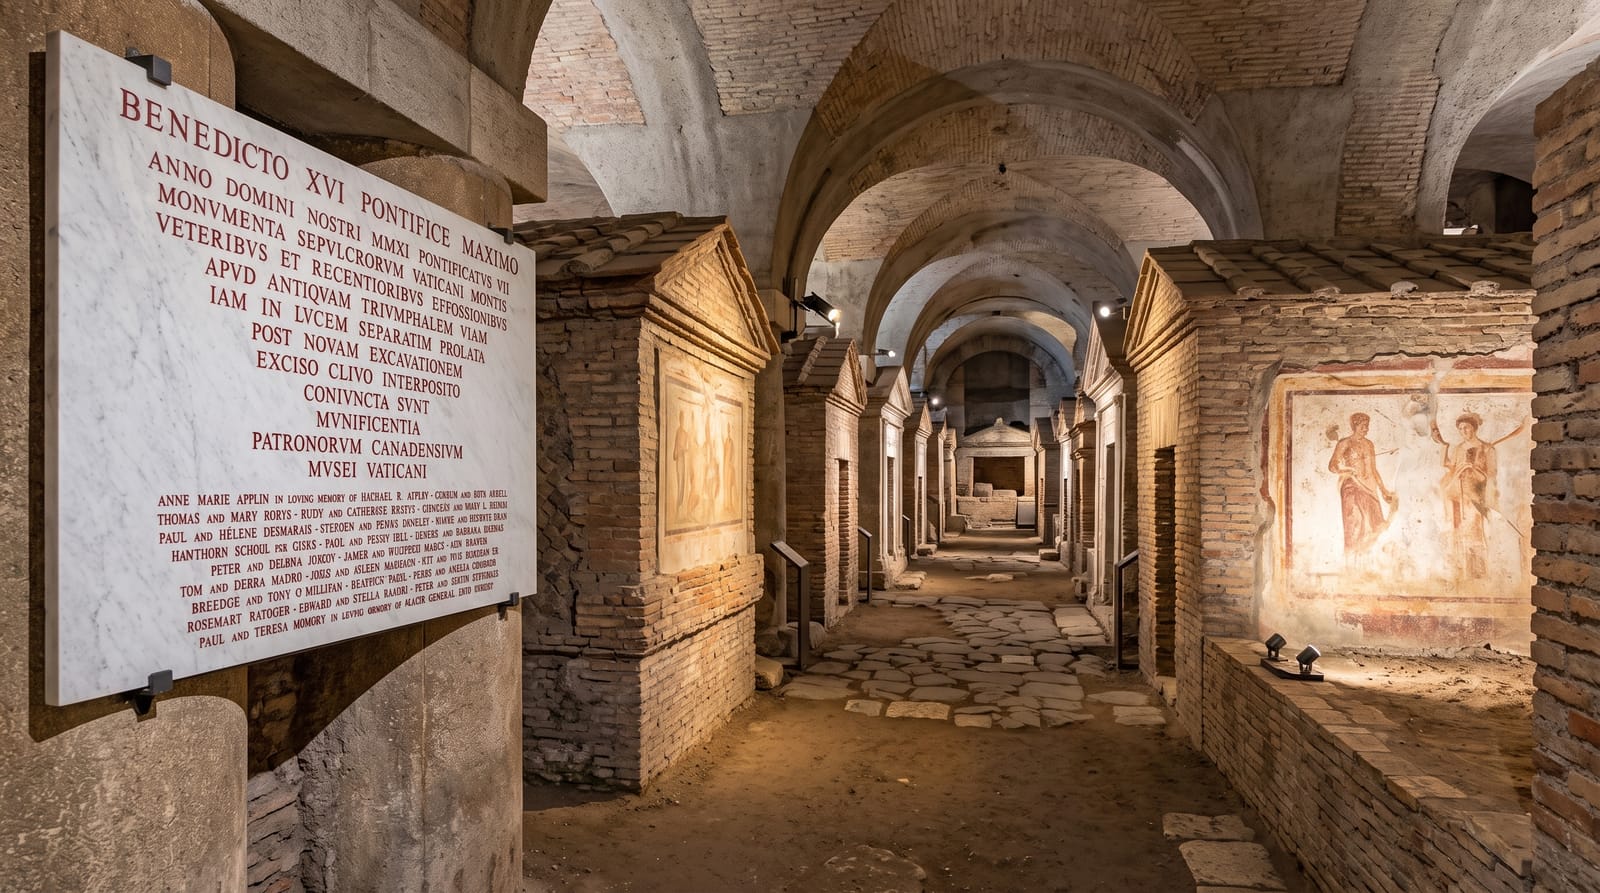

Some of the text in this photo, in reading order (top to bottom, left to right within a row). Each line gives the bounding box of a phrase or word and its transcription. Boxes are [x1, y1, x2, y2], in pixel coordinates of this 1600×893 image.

[120, 86, 518, 276] BENEDICTO XVI PONTIFICE MAXIMO
[149, 148, 509, 295] ANNO DOMINI NOSTRI MMXI PONTIFICATVS VII
[158, 181, 507, 313] MONVMENTA SEPVLCRORVM VATICANI MONTIS
[156, 211, 507, 331] VETERIBVS ET RECENTIORIBVS EFFOSSIONIBVS
[206, 256, 487, 344] APVD ANTIQVAM TRIVMPHALEM VIAM
[211, 285, 485, 363] IAM IN LVCEM SEPARATIM PROLATA
[252, 322, 462, 378] POST NOVAM EXCAVATIONEM
[257, 350, 460, 398] EXCISO CLIVO INTERPOSITO
[304, 384, 429, 414] CONIVNCTA SVNT
[252, 432, 462, 459] PATRONORVM CANADENSIVM
[317, 411, 420, 435] MVNIFICENTIA
[309, 461, 426, 478] MVSEI VATICANI
